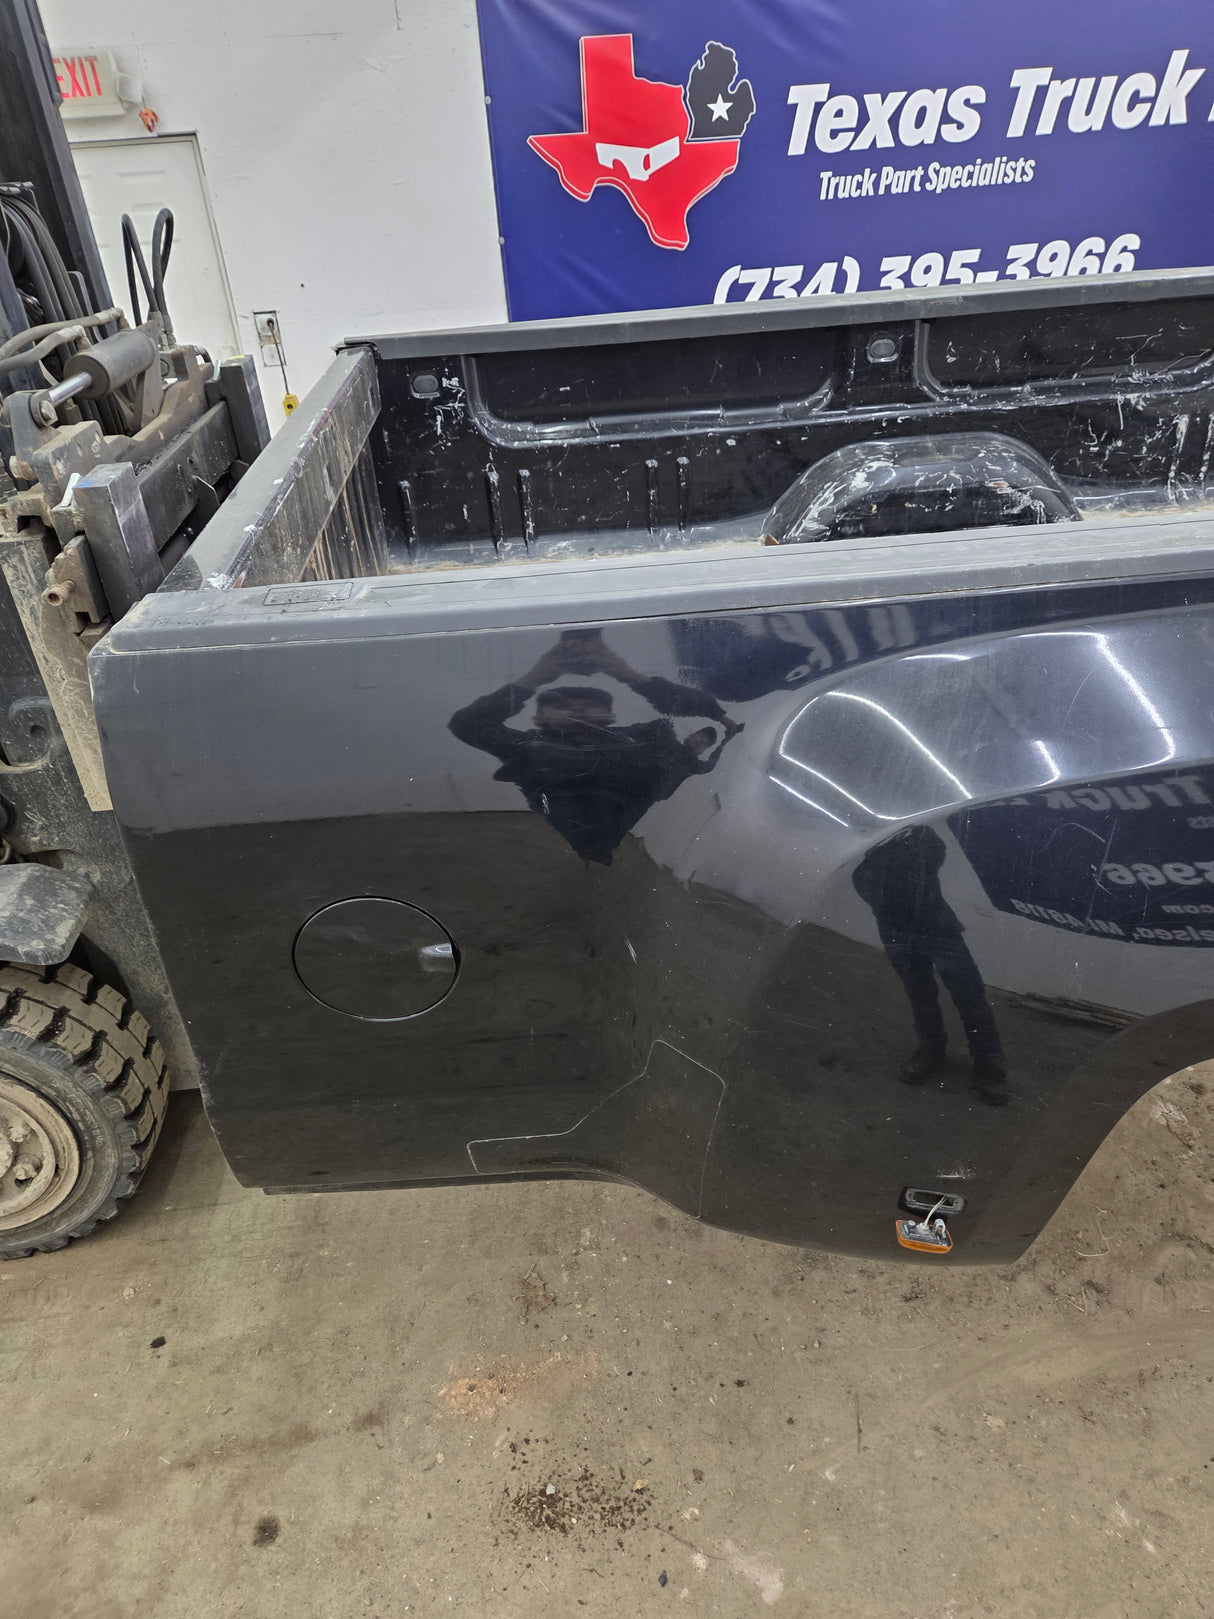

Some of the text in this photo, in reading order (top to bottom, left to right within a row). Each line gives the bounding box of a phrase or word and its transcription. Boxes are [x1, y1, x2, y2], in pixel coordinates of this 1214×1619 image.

[786, 49, 1206, 156] Texas Truck
[819, 156, 1036, 200] Truck Part Specialists
